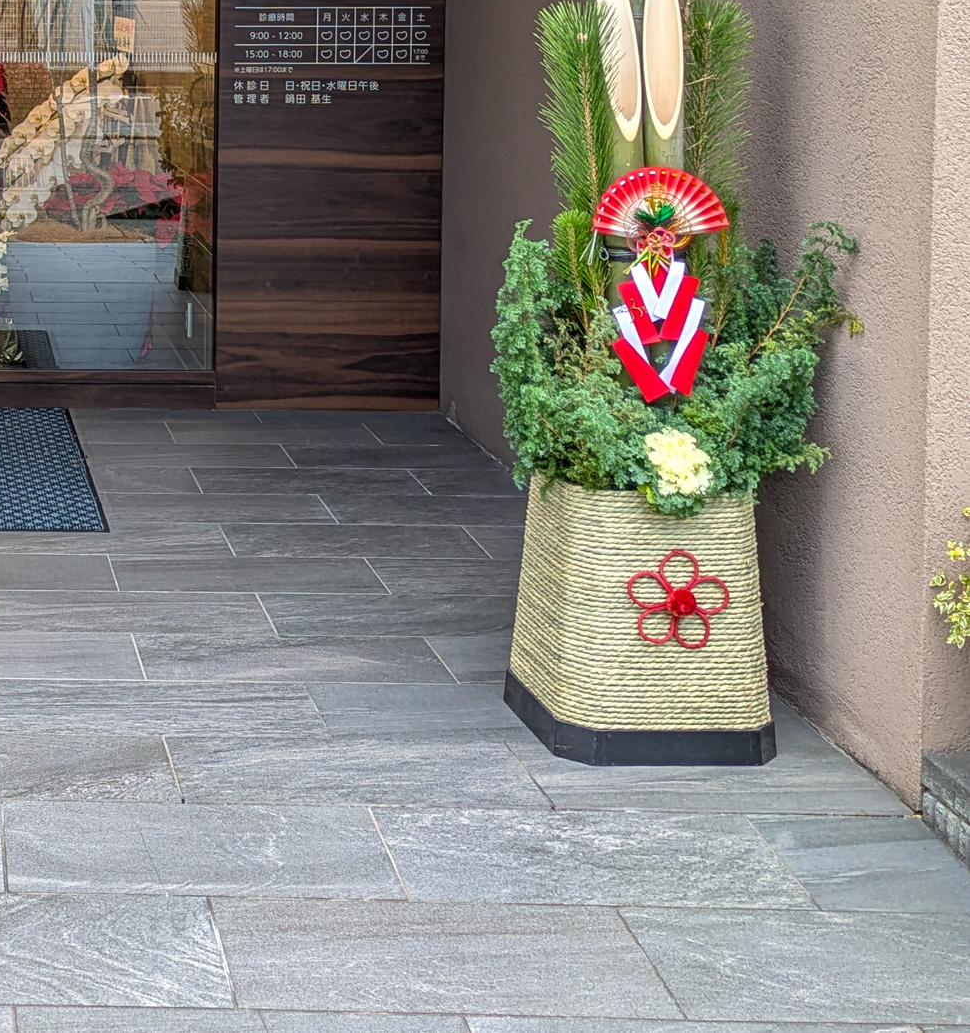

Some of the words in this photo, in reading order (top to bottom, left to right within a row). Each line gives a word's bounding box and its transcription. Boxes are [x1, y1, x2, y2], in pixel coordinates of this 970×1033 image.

[259, 13, 295, 22] 診療時間
[323, 13, 331, 22] 月
[342, 13, 350, 21] 火
[360, 13, 369, 21] 水
[379, 13, 388, 21] 木
[398, 12, 407, 21] 金
[416, 12, 426, 22] 土
[249, 32, 270, 40] 9:00
[278, 32, 303, 40] 12:00
[245, 50, 269, 59] 15:00
[278, 50, 303, 59] 18:00
